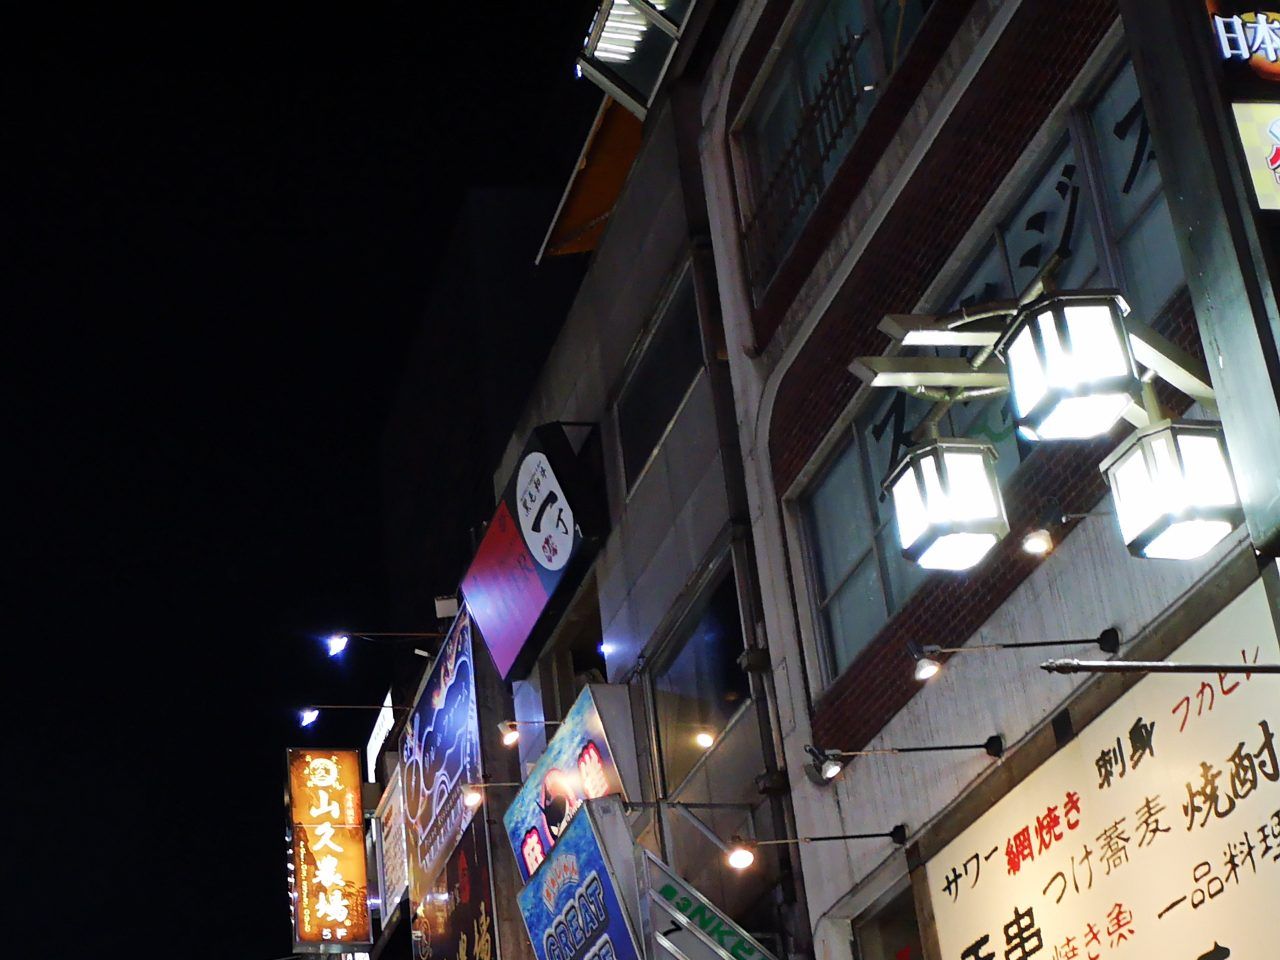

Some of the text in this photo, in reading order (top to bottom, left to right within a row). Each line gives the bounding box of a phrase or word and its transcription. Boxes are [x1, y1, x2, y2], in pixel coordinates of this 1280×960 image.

[1095, 715, 1157, 790] 刺身
[1181, 719, 1280, 833] 焼酎
[940, 844, 1000, 903] サワー
[1004, 790, 1082, 877] 網焼き
[1042, 794, 1172, 904] つけ蕎麦
[1156, 812, 1280, 920] 一品料理
[322, 927, 349, 940] 5F
[662, 919, 683, 938] 7
